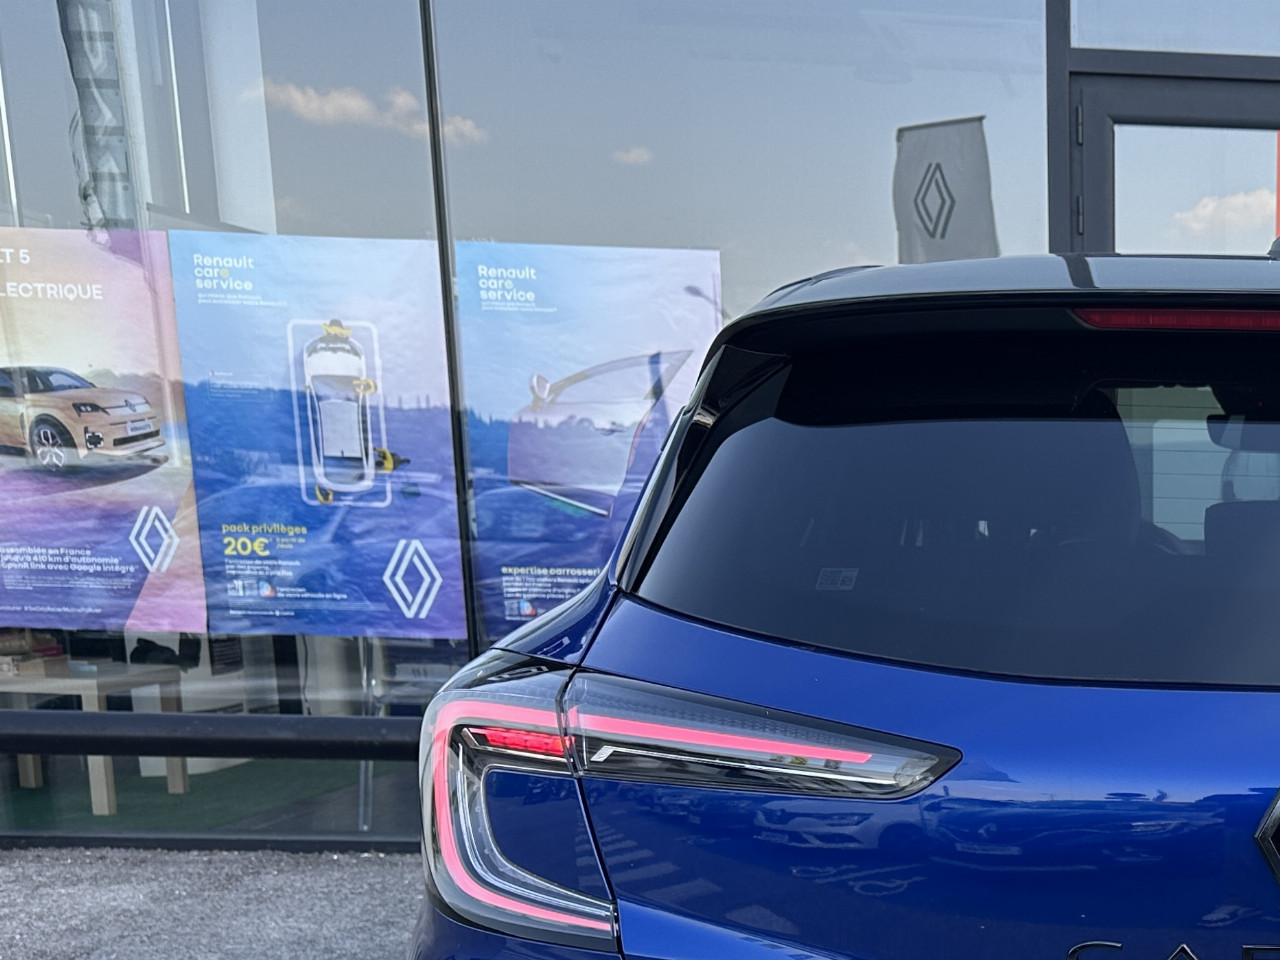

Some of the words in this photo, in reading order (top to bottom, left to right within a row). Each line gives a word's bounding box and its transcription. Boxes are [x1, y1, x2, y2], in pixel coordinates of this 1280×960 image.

[19, 248, 31, 264] 5
[193, 253, 255, 269] Renault
[194, 267, 230, 278] care
[477, 264, 537, 280] Renault
[195, 277, 254, 291] service
[478, 278, 514, 289] care
[479, 288, 536, 302] service
[222, 522, 250, 535] pack
[501, 565, 548, 577] expertise
